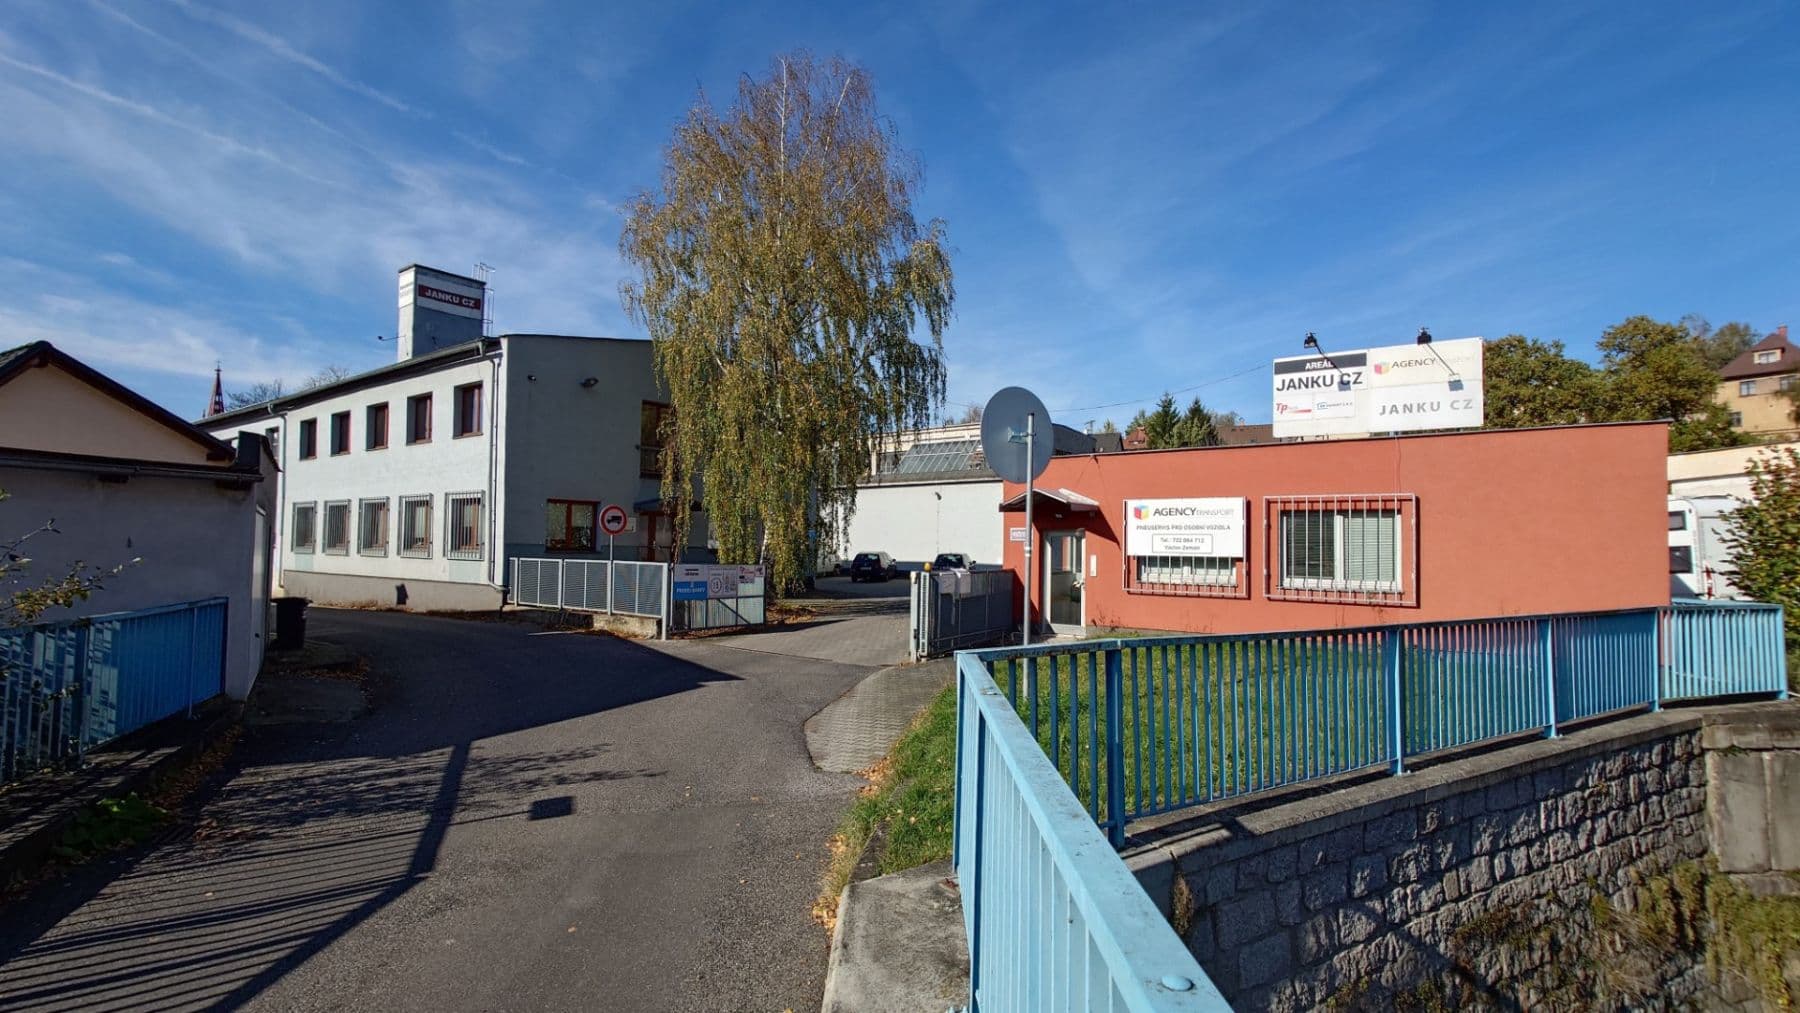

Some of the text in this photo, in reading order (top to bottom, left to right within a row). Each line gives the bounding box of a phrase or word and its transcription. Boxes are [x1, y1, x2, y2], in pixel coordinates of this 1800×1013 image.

[425, 289, 476, 307] JANKU CZ
[1391, 357, 1436, 368] AGENCY
[1276, 371, 1364, 392] JANKU CZ
[1379, 399, 1473, 416] JANKU CZ
